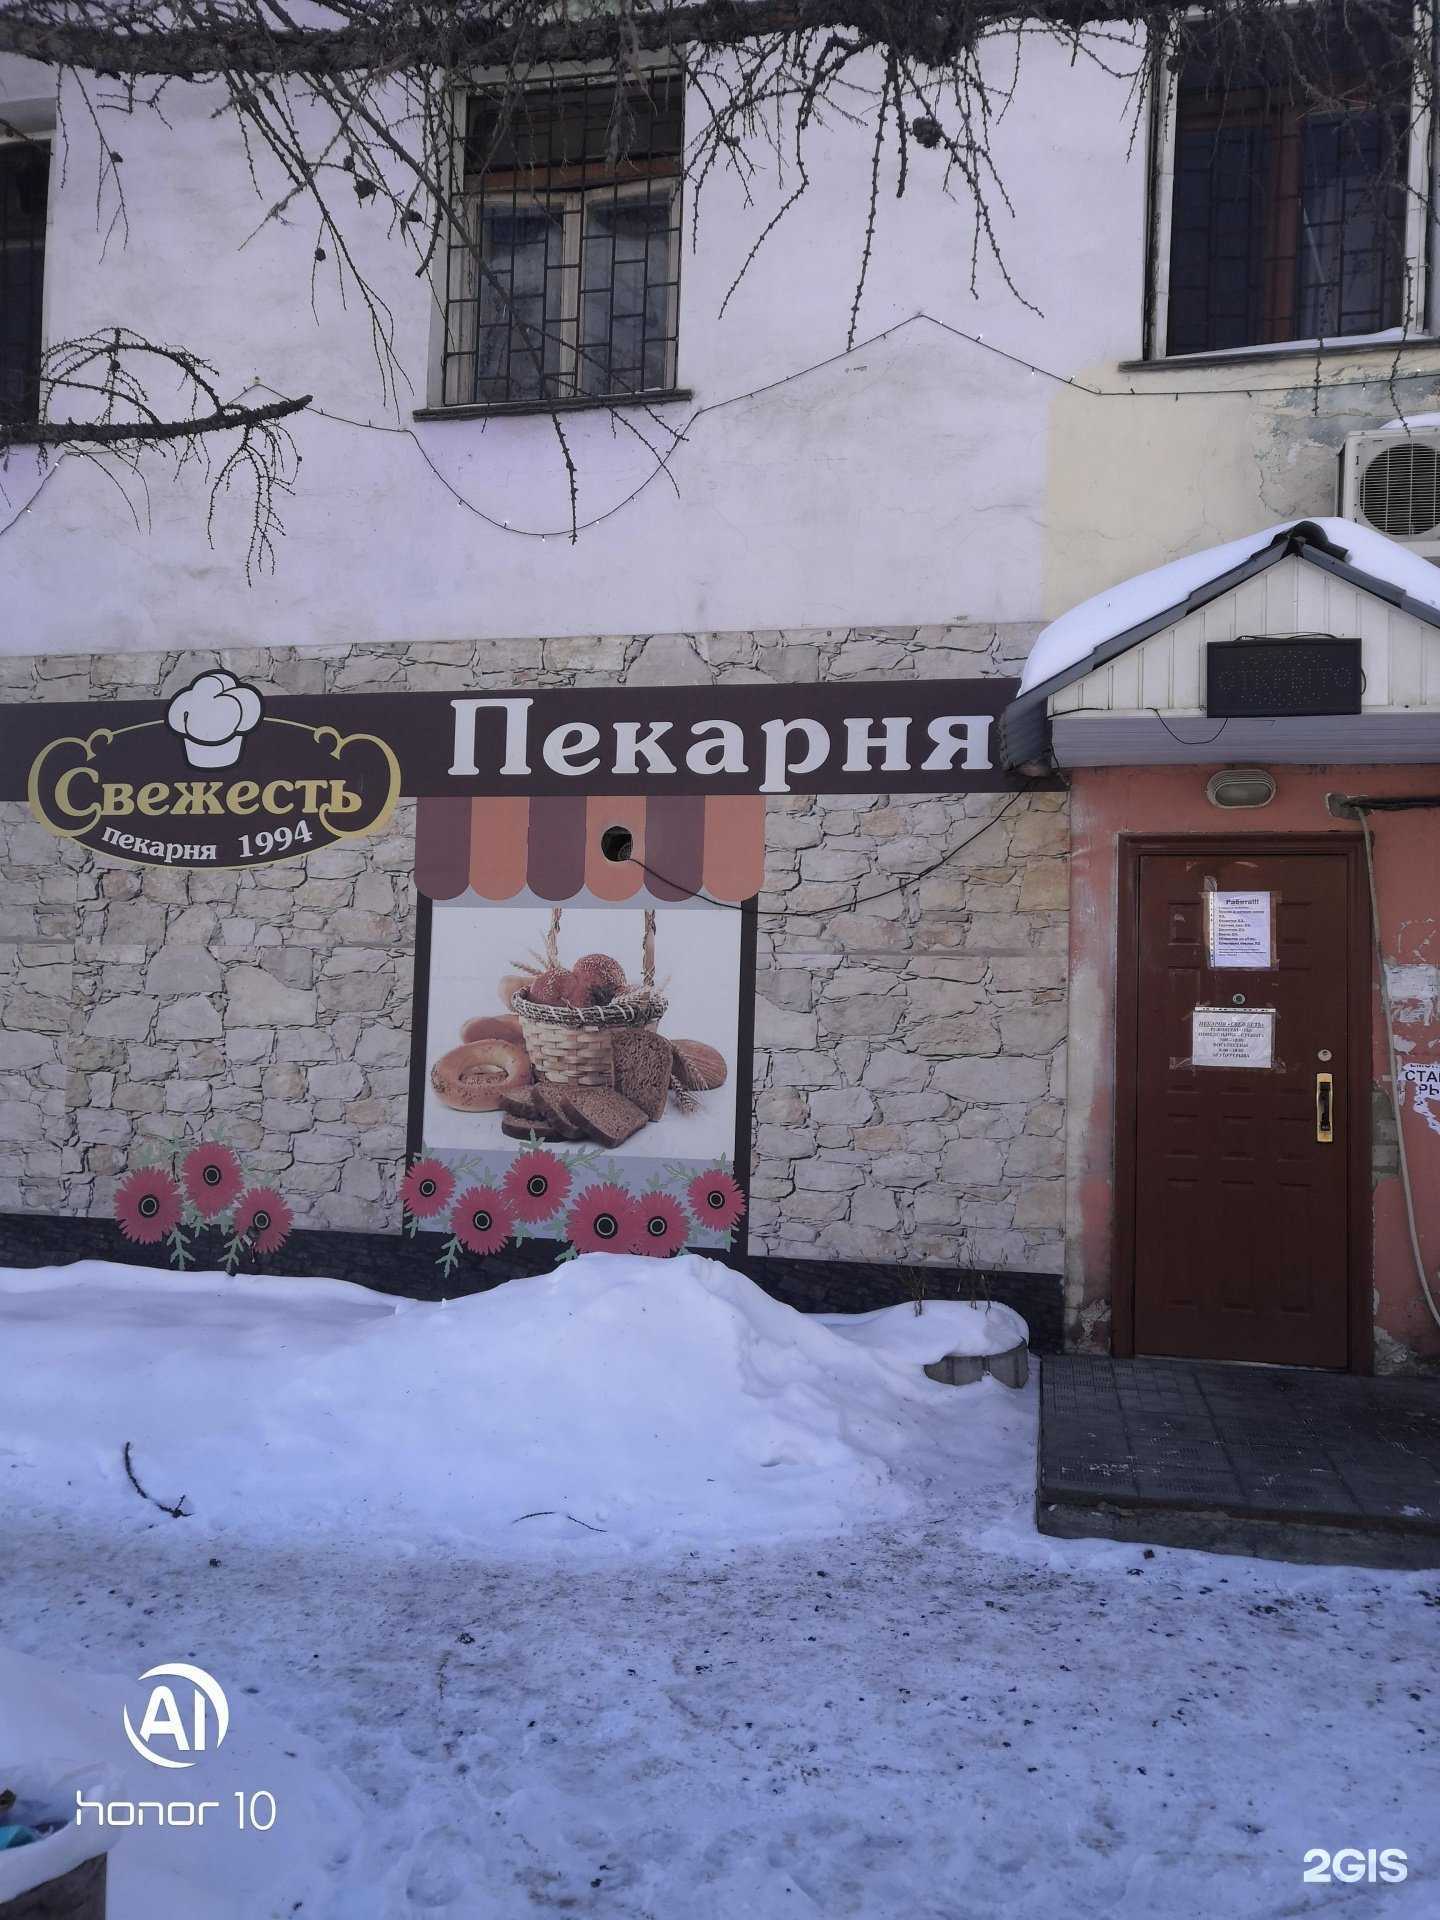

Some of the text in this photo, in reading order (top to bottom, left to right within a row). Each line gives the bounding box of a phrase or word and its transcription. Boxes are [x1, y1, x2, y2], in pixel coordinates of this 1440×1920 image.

[447, 697, 995, 794] Пекарня
[54, 766, 363, 818] Свежесть
[102, 819, 313, 864] пекарня 1994
